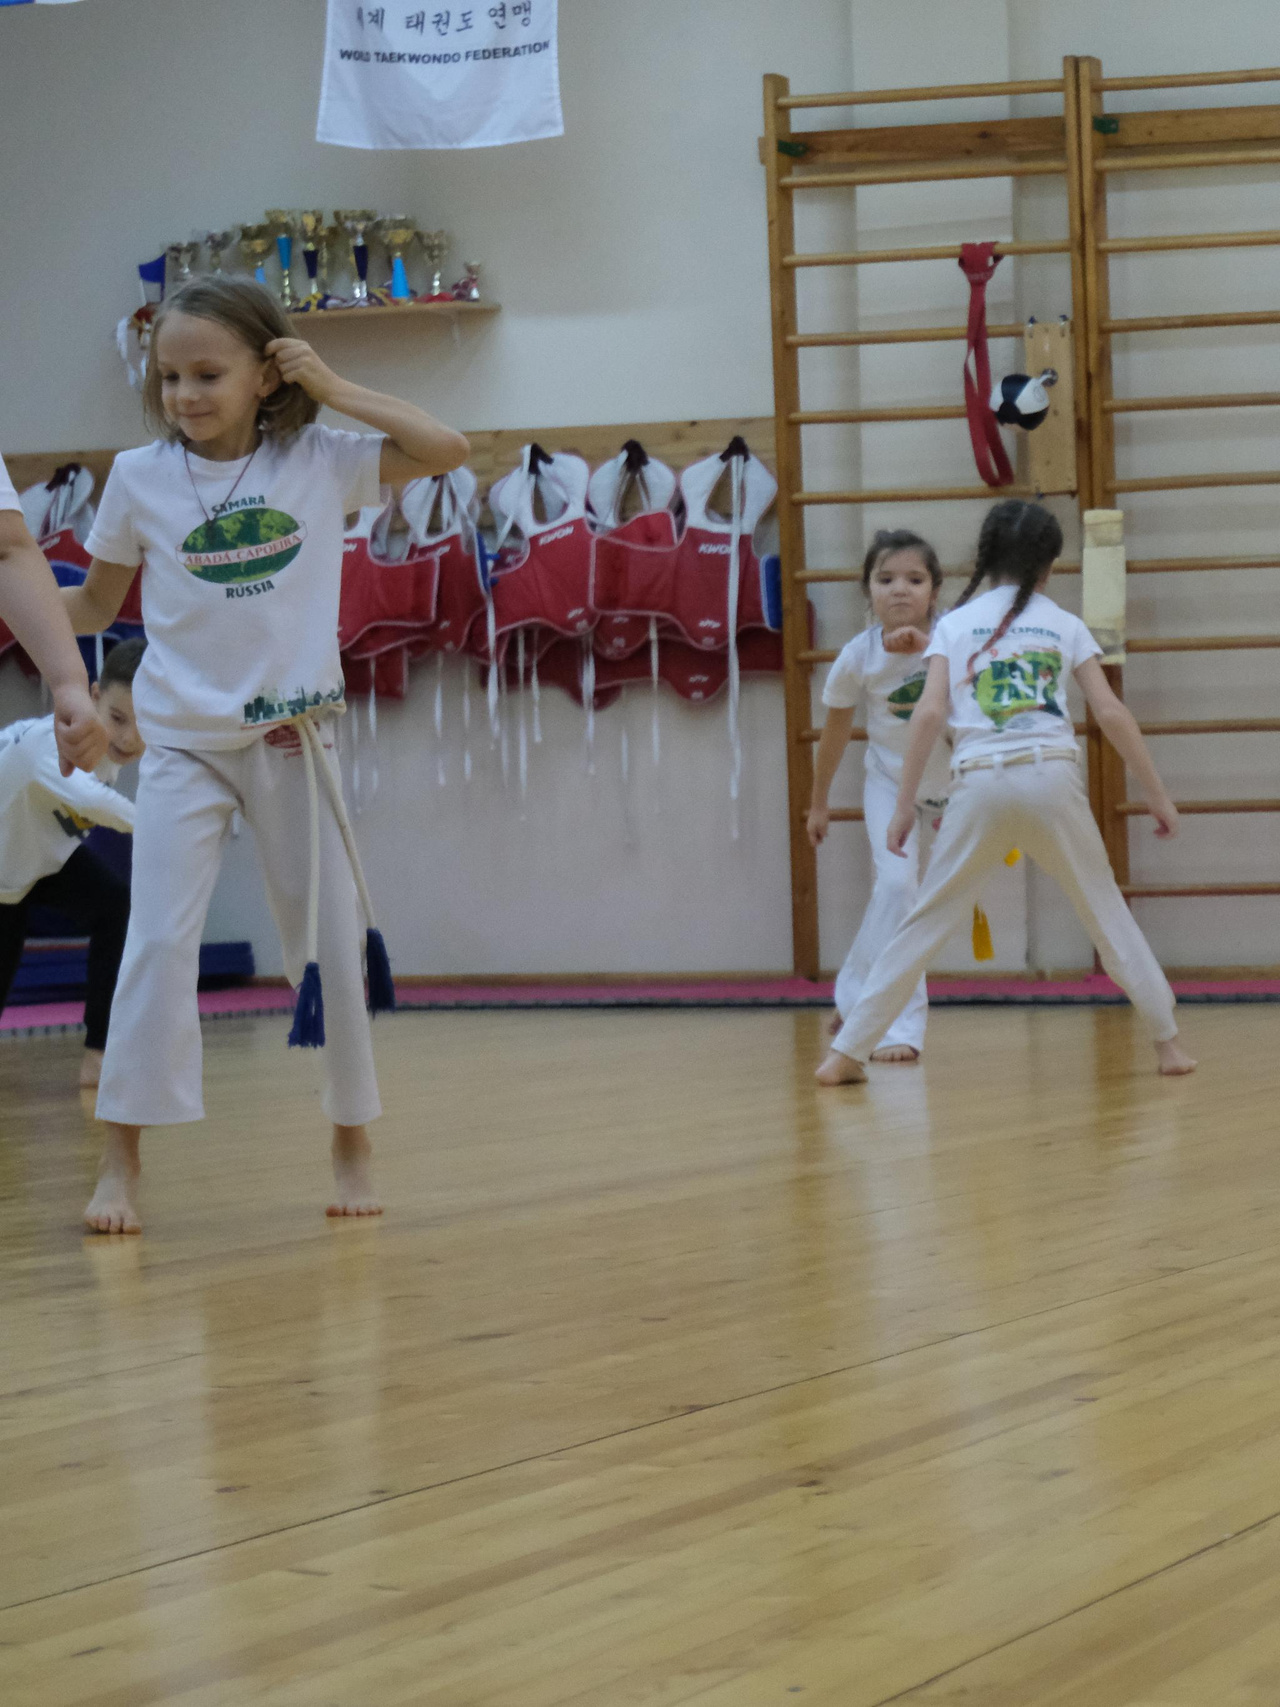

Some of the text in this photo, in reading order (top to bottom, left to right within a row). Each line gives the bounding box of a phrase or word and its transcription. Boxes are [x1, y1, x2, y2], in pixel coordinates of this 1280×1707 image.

[405, 11, 474, 36] 태권도
[488, 0, 532, 29] 연맹
[375, 51, 461, 64] TAEKWONDO
[464, 40, 550, 61] FEDERATION
[211, 495, 266, 514] SAMARA
[698, 543, 731, 555] KWO
